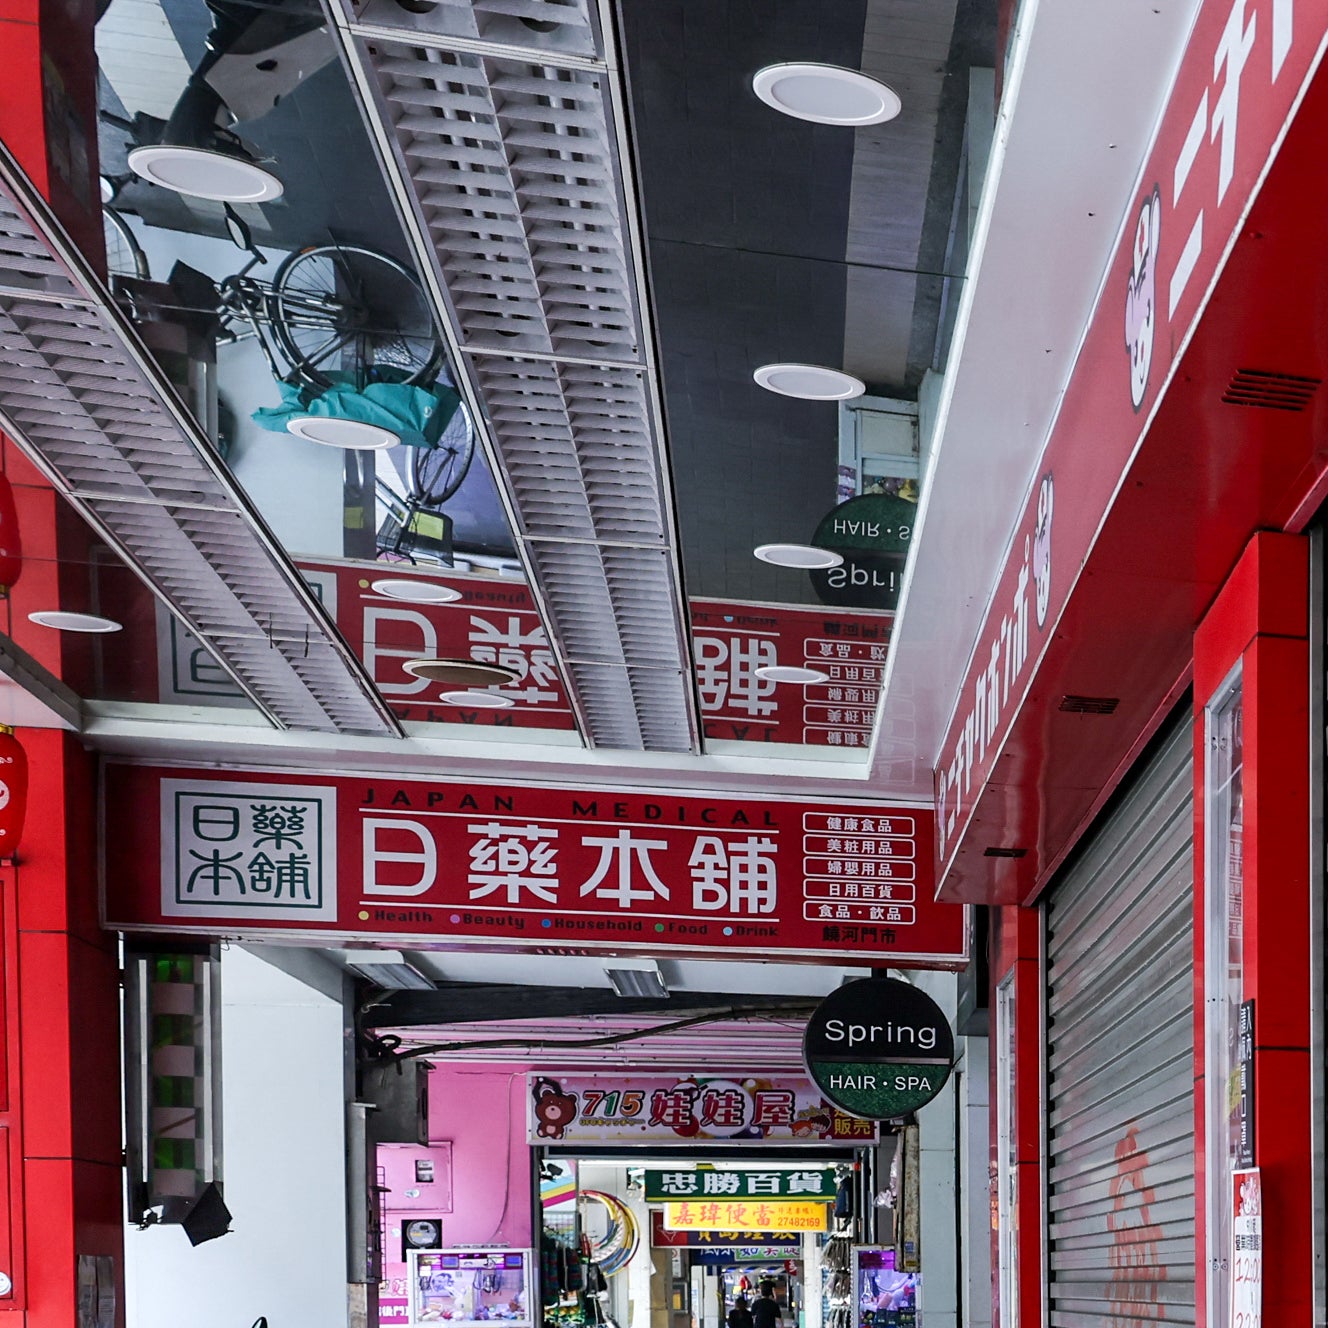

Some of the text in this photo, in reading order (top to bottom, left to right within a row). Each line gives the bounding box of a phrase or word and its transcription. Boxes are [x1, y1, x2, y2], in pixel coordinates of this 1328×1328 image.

[361, 788, 779, 827] JAPAN MEDICAL
[826, 816, 893, 833] 健康食品
[826, 838, 893, 855] 美粧用品
[362, 816, 778, 914] 日藥本舖
[826, 860, 893, 877] 婦嬰用品
[828, 883, 893, 899] 日用百貨
[374, 910, 778, 937] Health Beauty Household Food Drink
[821, 925, 897, 944] 饒河門市
[824, 1019, 936, 1050] Spring
[829, 1075, 932, 1091] HAIR SPA
[581, 1089, 797, 1127] 715 娃娃屋
[834, 1118, 872, 1136] 販売
[661, 1172, 824, 1195] 忠勝百貨
[673, 1201, 777, 1227] 嘉瑋便當
[777, 1217, 821, 1227] 27482169
